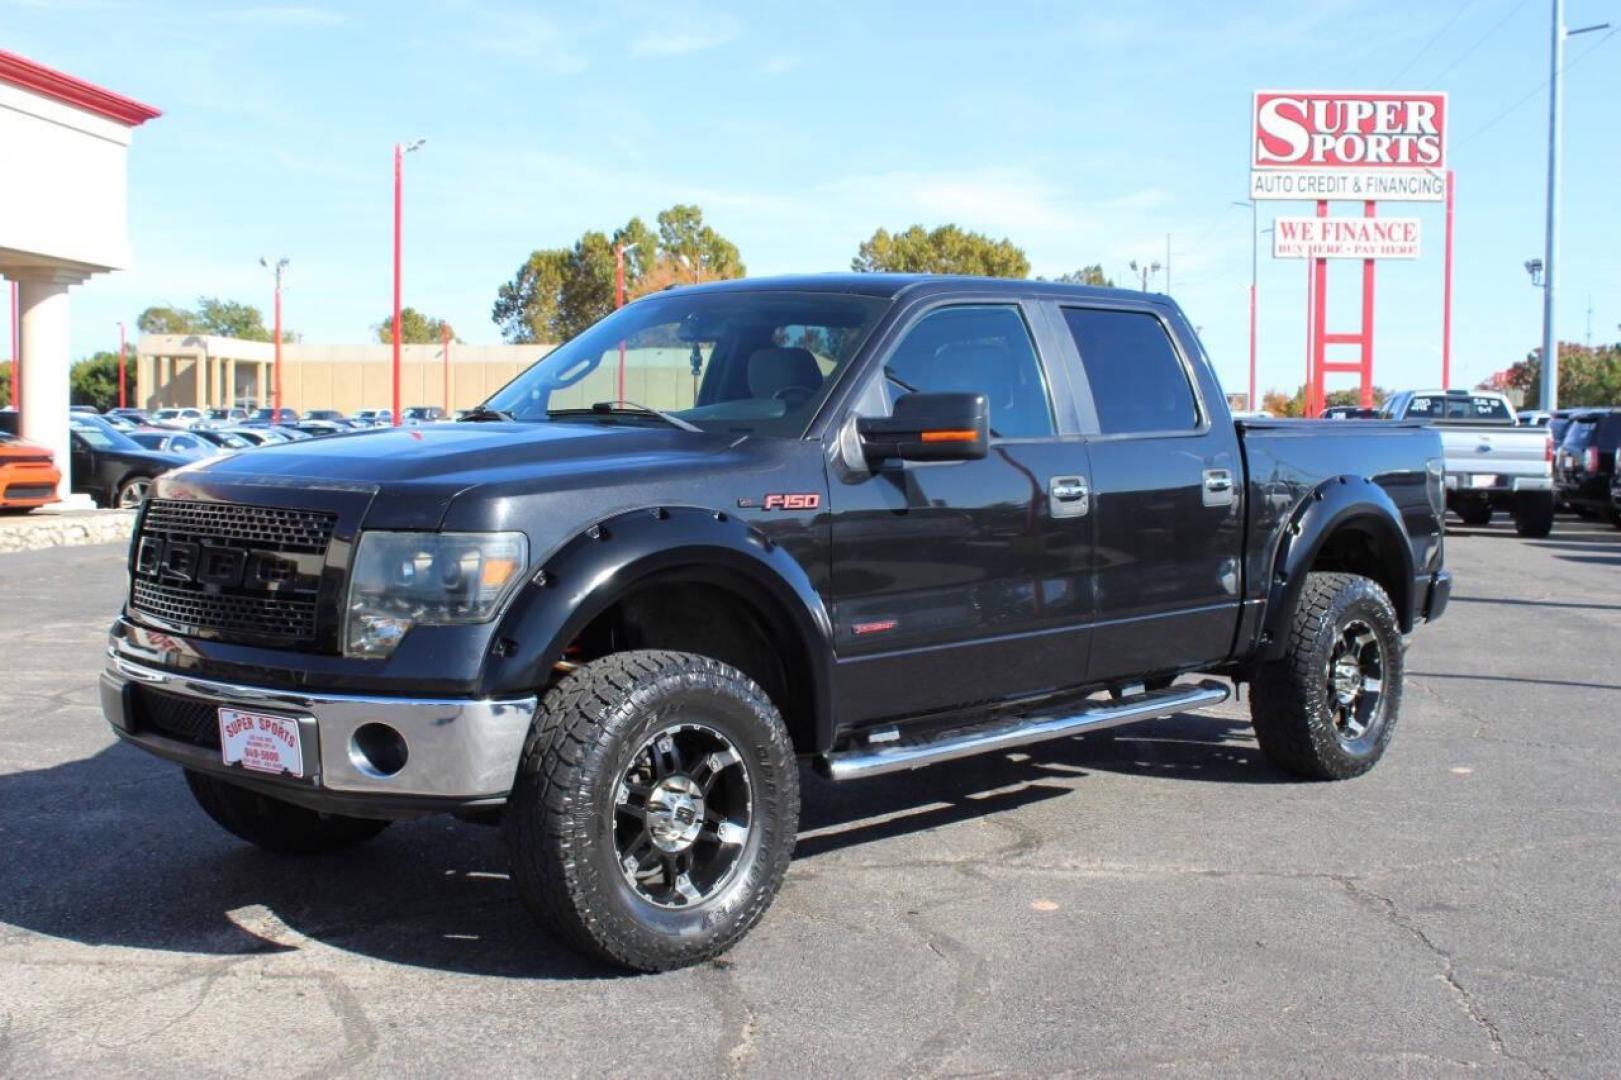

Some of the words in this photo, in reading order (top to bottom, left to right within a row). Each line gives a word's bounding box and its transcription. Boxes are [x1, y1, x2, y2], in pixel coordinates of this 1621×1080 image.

[1255, 175, 1293, 193] AUTO
[1297, 175, 1346, 193] CREDIT
[1353, 176, 1362, 193] &
[1366, 176, 1444, 195] FINANCING
[1279, 222, 1314, 241] WE
[1321, 222, 1417, 242] FINANCE
[764, 494, 820, 510] F-150
[226, 716, 254, 738] SUPER
[259, 718, 296, 748] SPORTS
